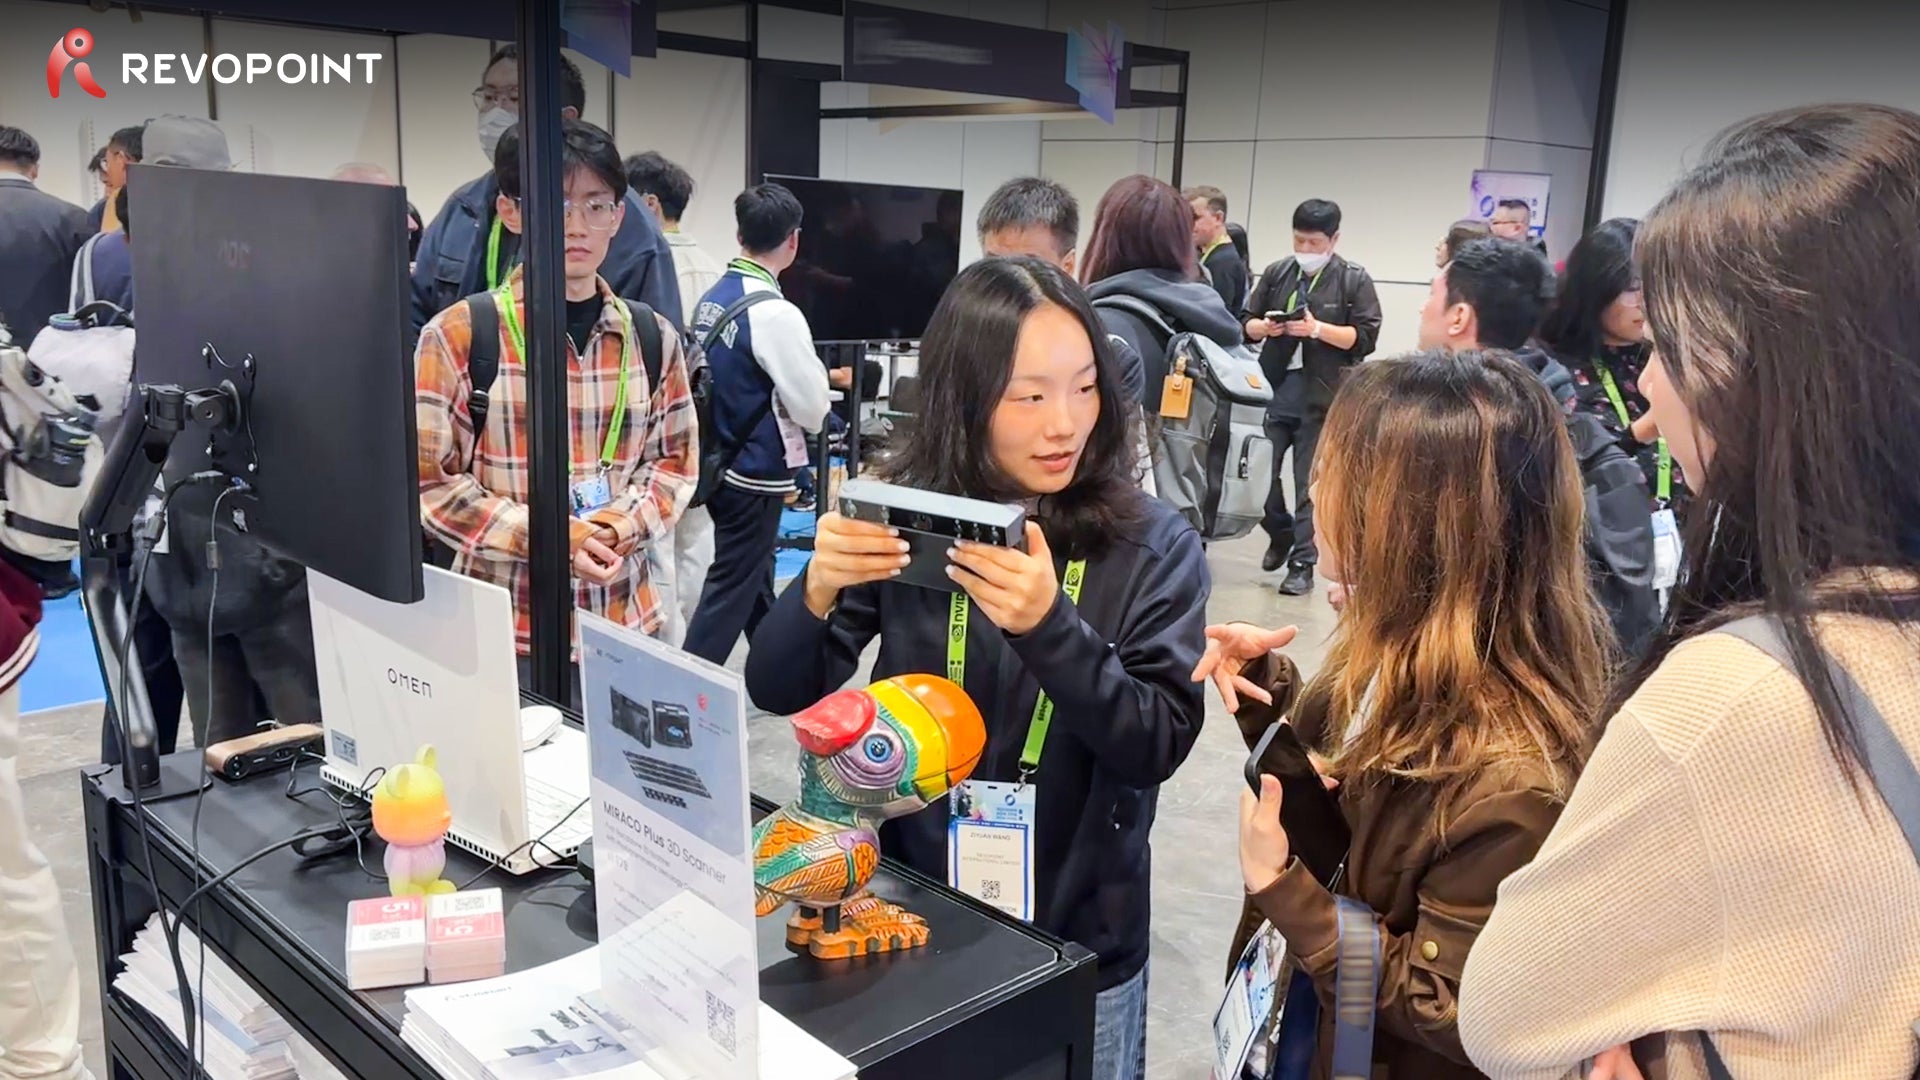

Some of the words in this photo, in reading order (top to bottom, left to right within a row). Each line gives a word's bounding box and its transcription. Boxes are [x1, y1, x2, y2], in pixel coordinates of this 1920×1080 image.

[388, 668, 432, 699] OMEN
[604, 801, 642, 833] MIRACO
[644, 825, 665, 848] Plus
[667, 839, 681, 857] 3D
[682, 848, 727, 884] Scanner
